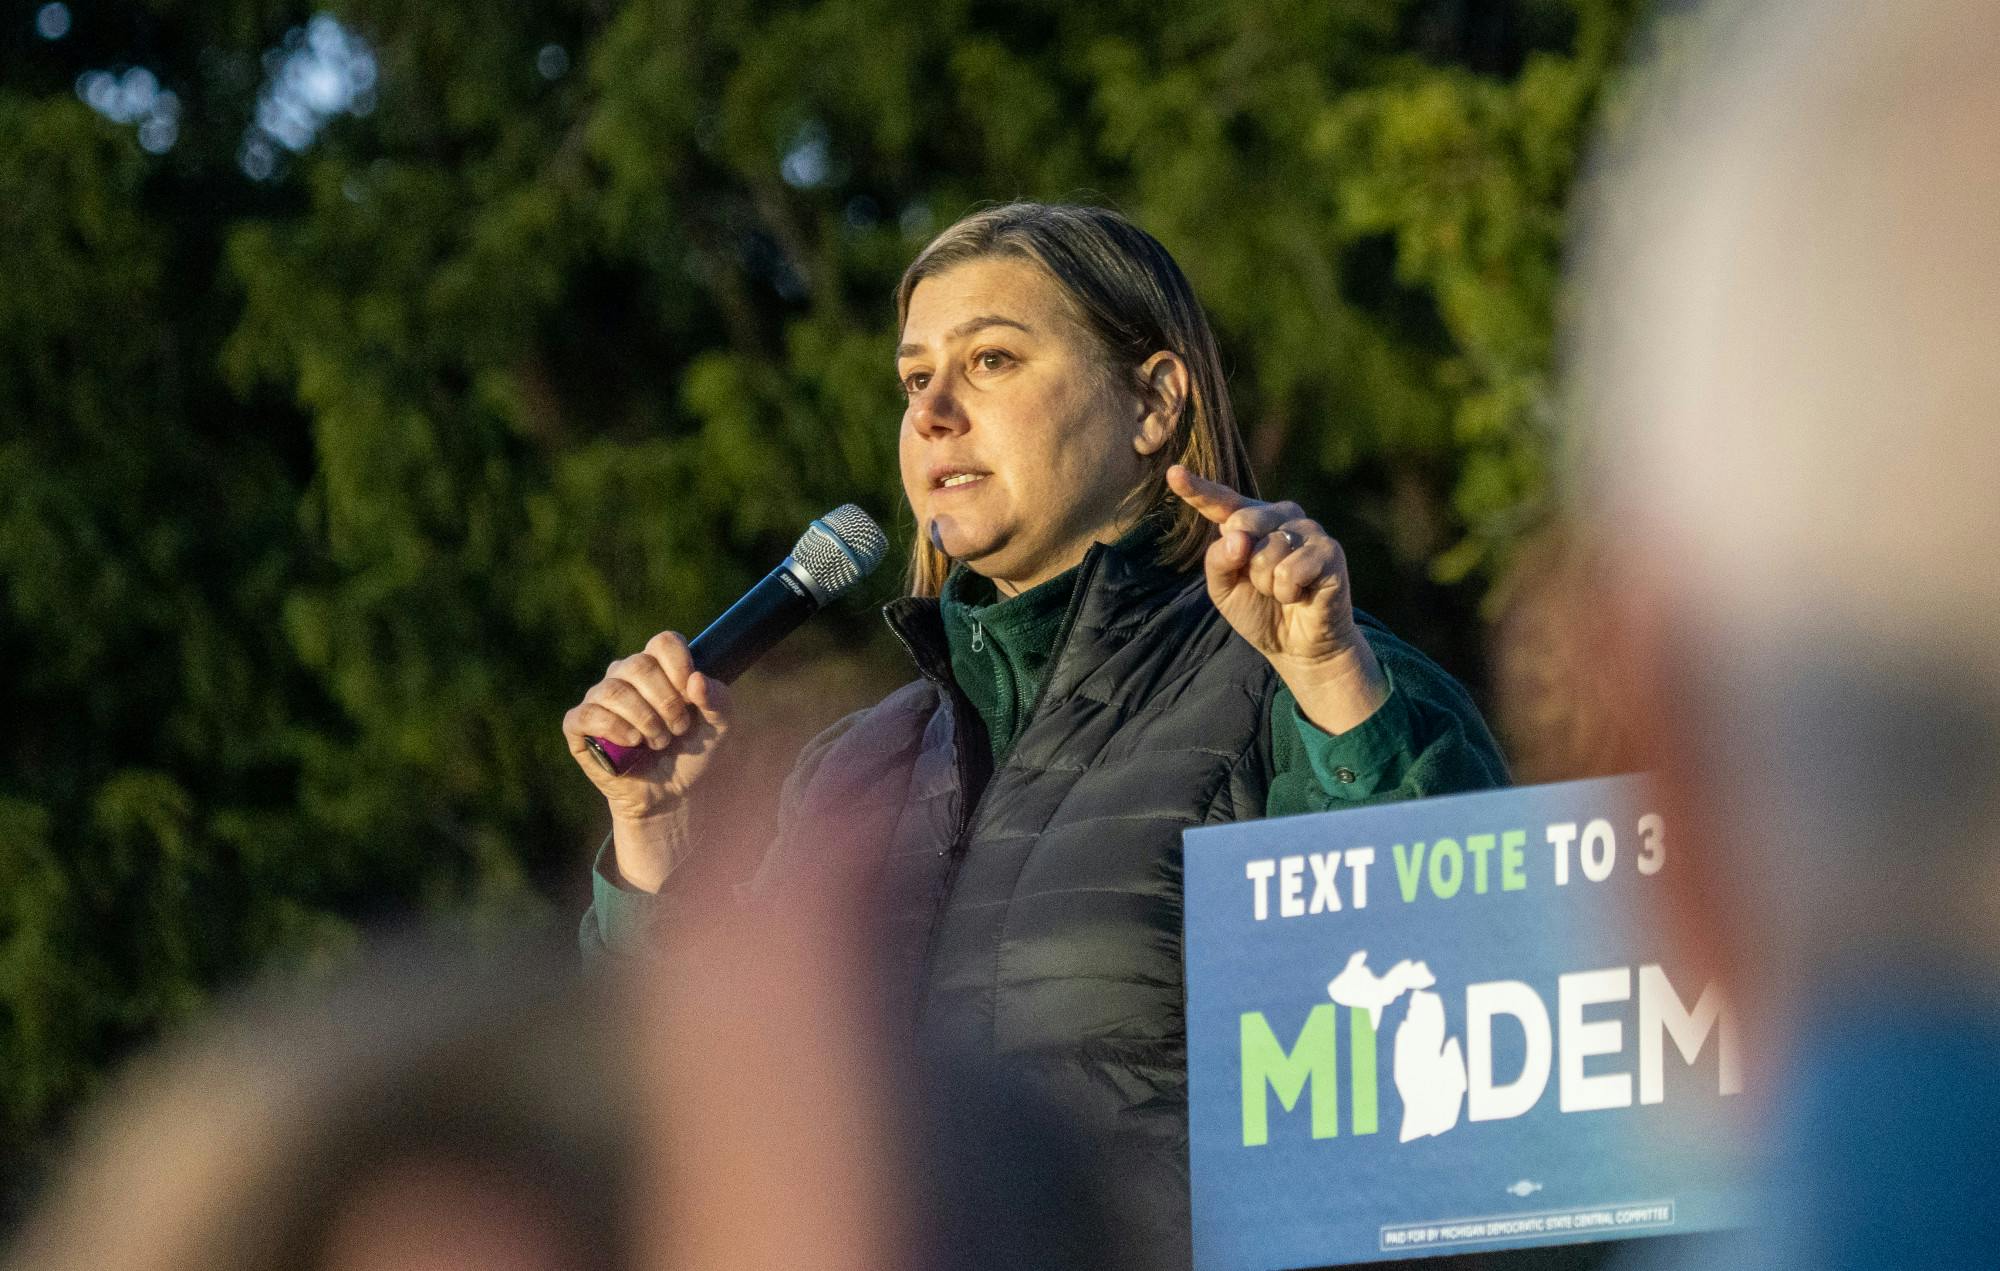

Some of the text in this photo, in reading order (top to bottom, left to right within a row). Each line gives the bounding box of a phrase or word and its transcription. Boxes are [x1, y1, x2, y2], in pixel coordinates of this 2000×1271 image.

[1246, 847, 1375, 921] TEXT
[1393, 831, 1528, 903] VOTE
[1546, 819, 1617, 886] TO
[1385, 1206, 1669, 1245] PAID FOR BY MICHIGAN DEMOCRATIC STATE CENTRAL COMMITTEE
